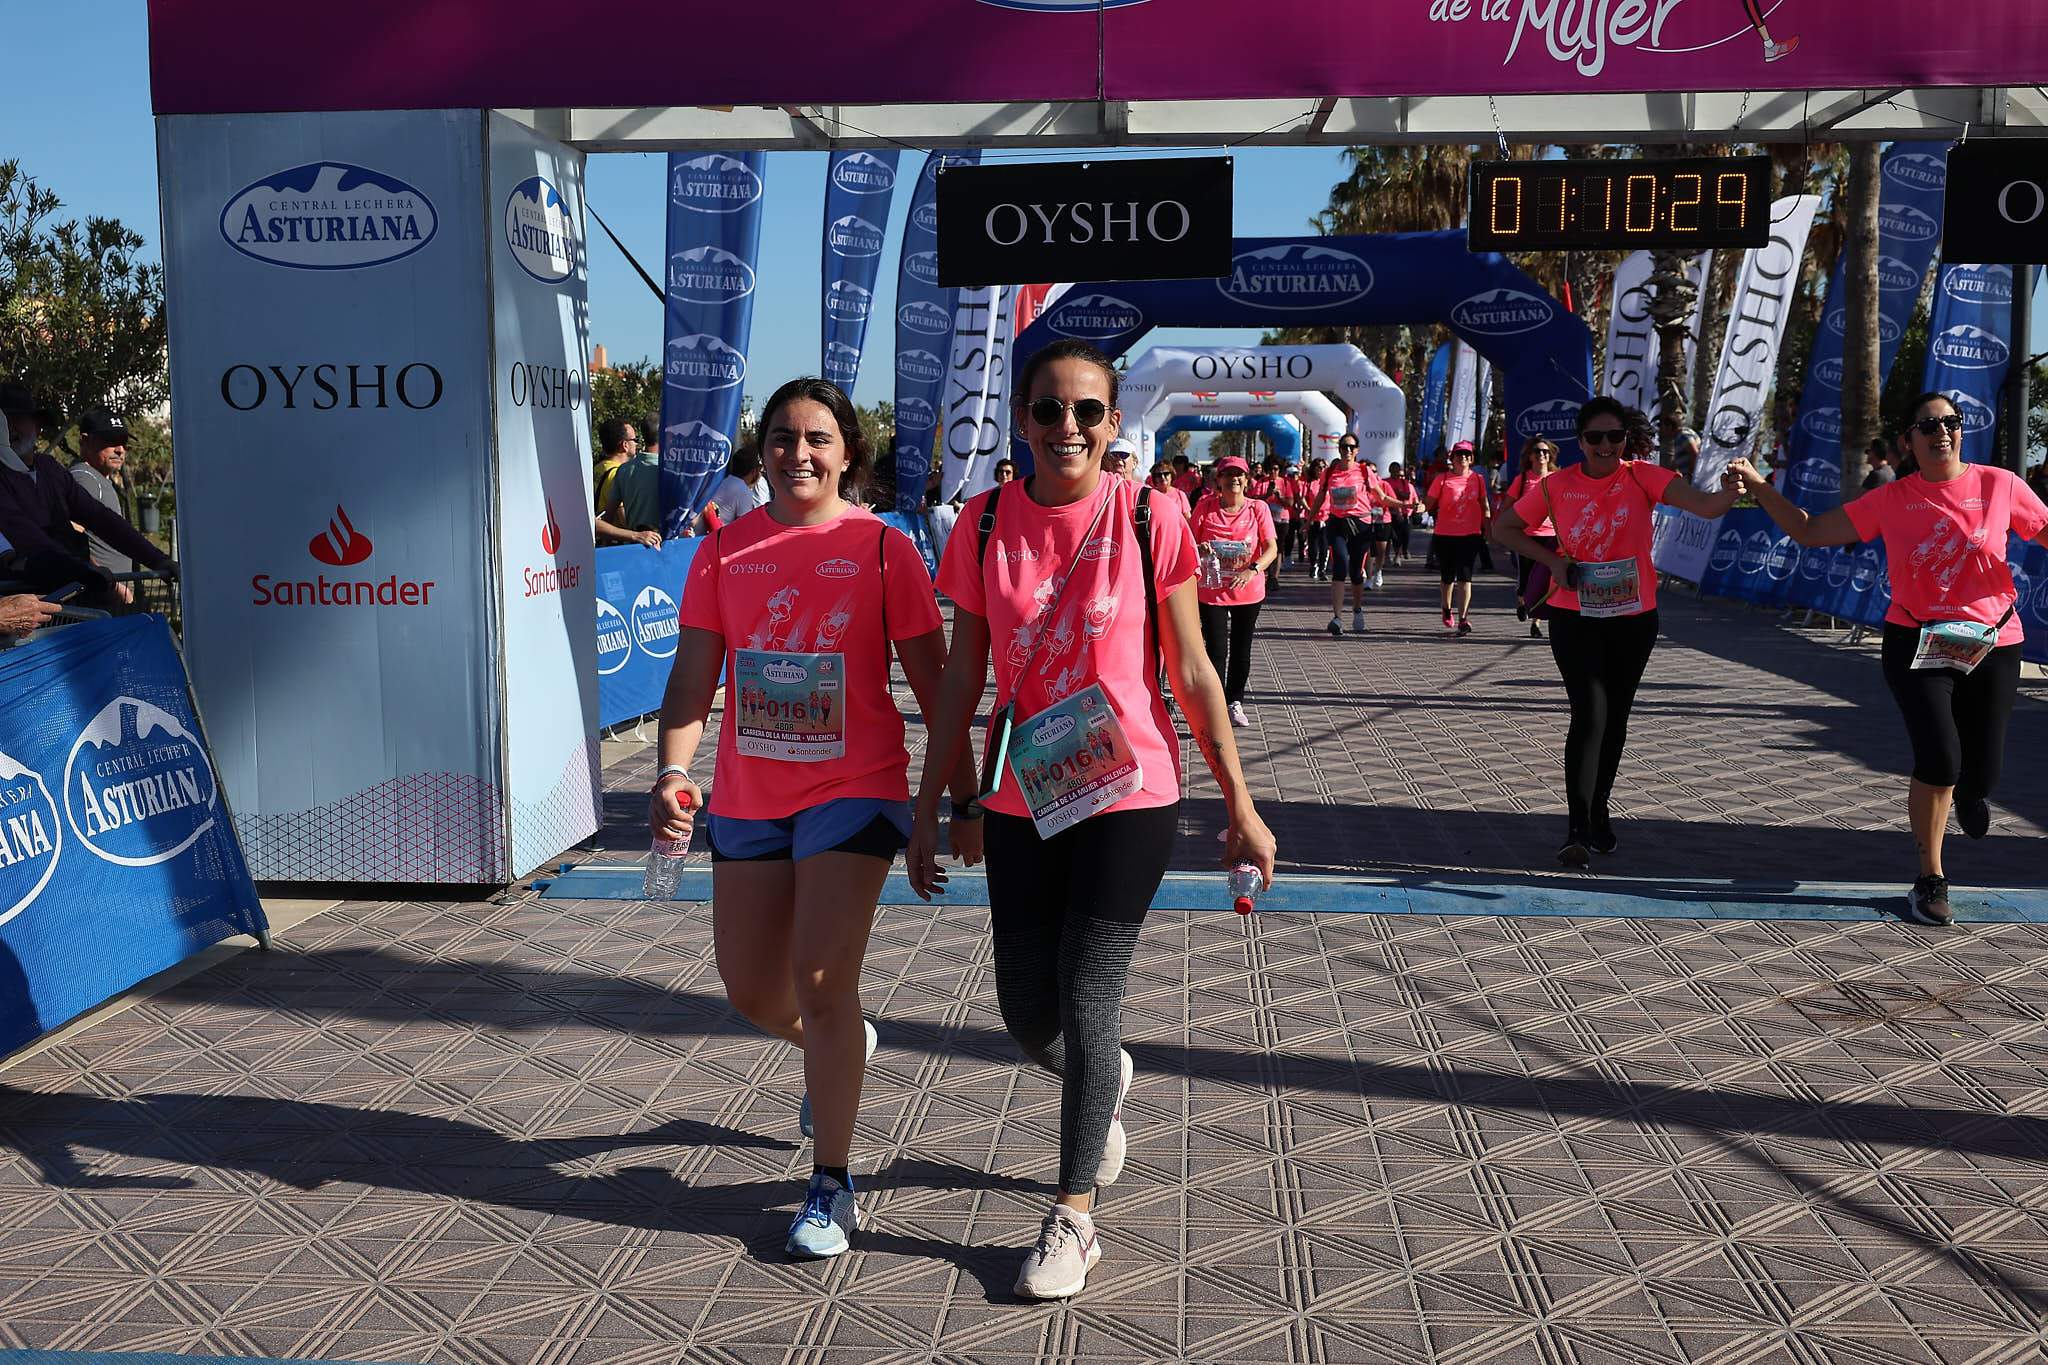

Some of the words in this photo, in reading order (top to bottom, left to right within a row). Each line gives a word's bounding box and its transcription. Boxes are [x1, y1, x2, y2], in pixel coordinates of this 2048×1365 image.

[269, 201, 337, 211] CENTRAL
[344, 199, 415, 210] LECHERA
[237, 203, 423, 243] ASTURIANA
[985, 200, 1190, 245] OYSHO
[1228, 266, 1363, 294] ASTURIANA
[1053, 311, 1135, 328] ASTURIANA
[1459, 308, 1547, 326] ASTURIANA
[1711, 234, 1795, 448] OYSHO
[1192, 354, 1313, 380] OYSHO
[220, 362, 444, 411] OYSHO
[511, 361, 581, 411] OYSHO
[523, 563, 581, 598] Santander
[729, 563, 777, 575] OYSHO
[252, 574, 435, 606] Santander
[765, 667, 805, 680] ASTURIANA
[767, 699, 806, 719] 016
[742, 728, 765, 737] CARRERA
[781, 732, 801, 740] MUJER
[747, 740, 777, 753] OYSHO
[796, 747, 832, 755] Santander
[1033, 720, 1074, 745] ASTURIANA
[97, 754, 145, 778] CENTRAL
[149, 742, 191, 764] LECHER
[1049, 749, 1094, 782] 016
[81, 767, 207, 837] ASTURIAN
[1036, 801, 1061, 818] CARRERA
[1069, 792, 1078, 802] LA
[1077, 781, 1099, 798] MUJER
[1101, 764, 1133, 785] VALENCIA
[1047, 806, 1079, 828] OYSHO
[1099, 780, 1134, 803] Santander
